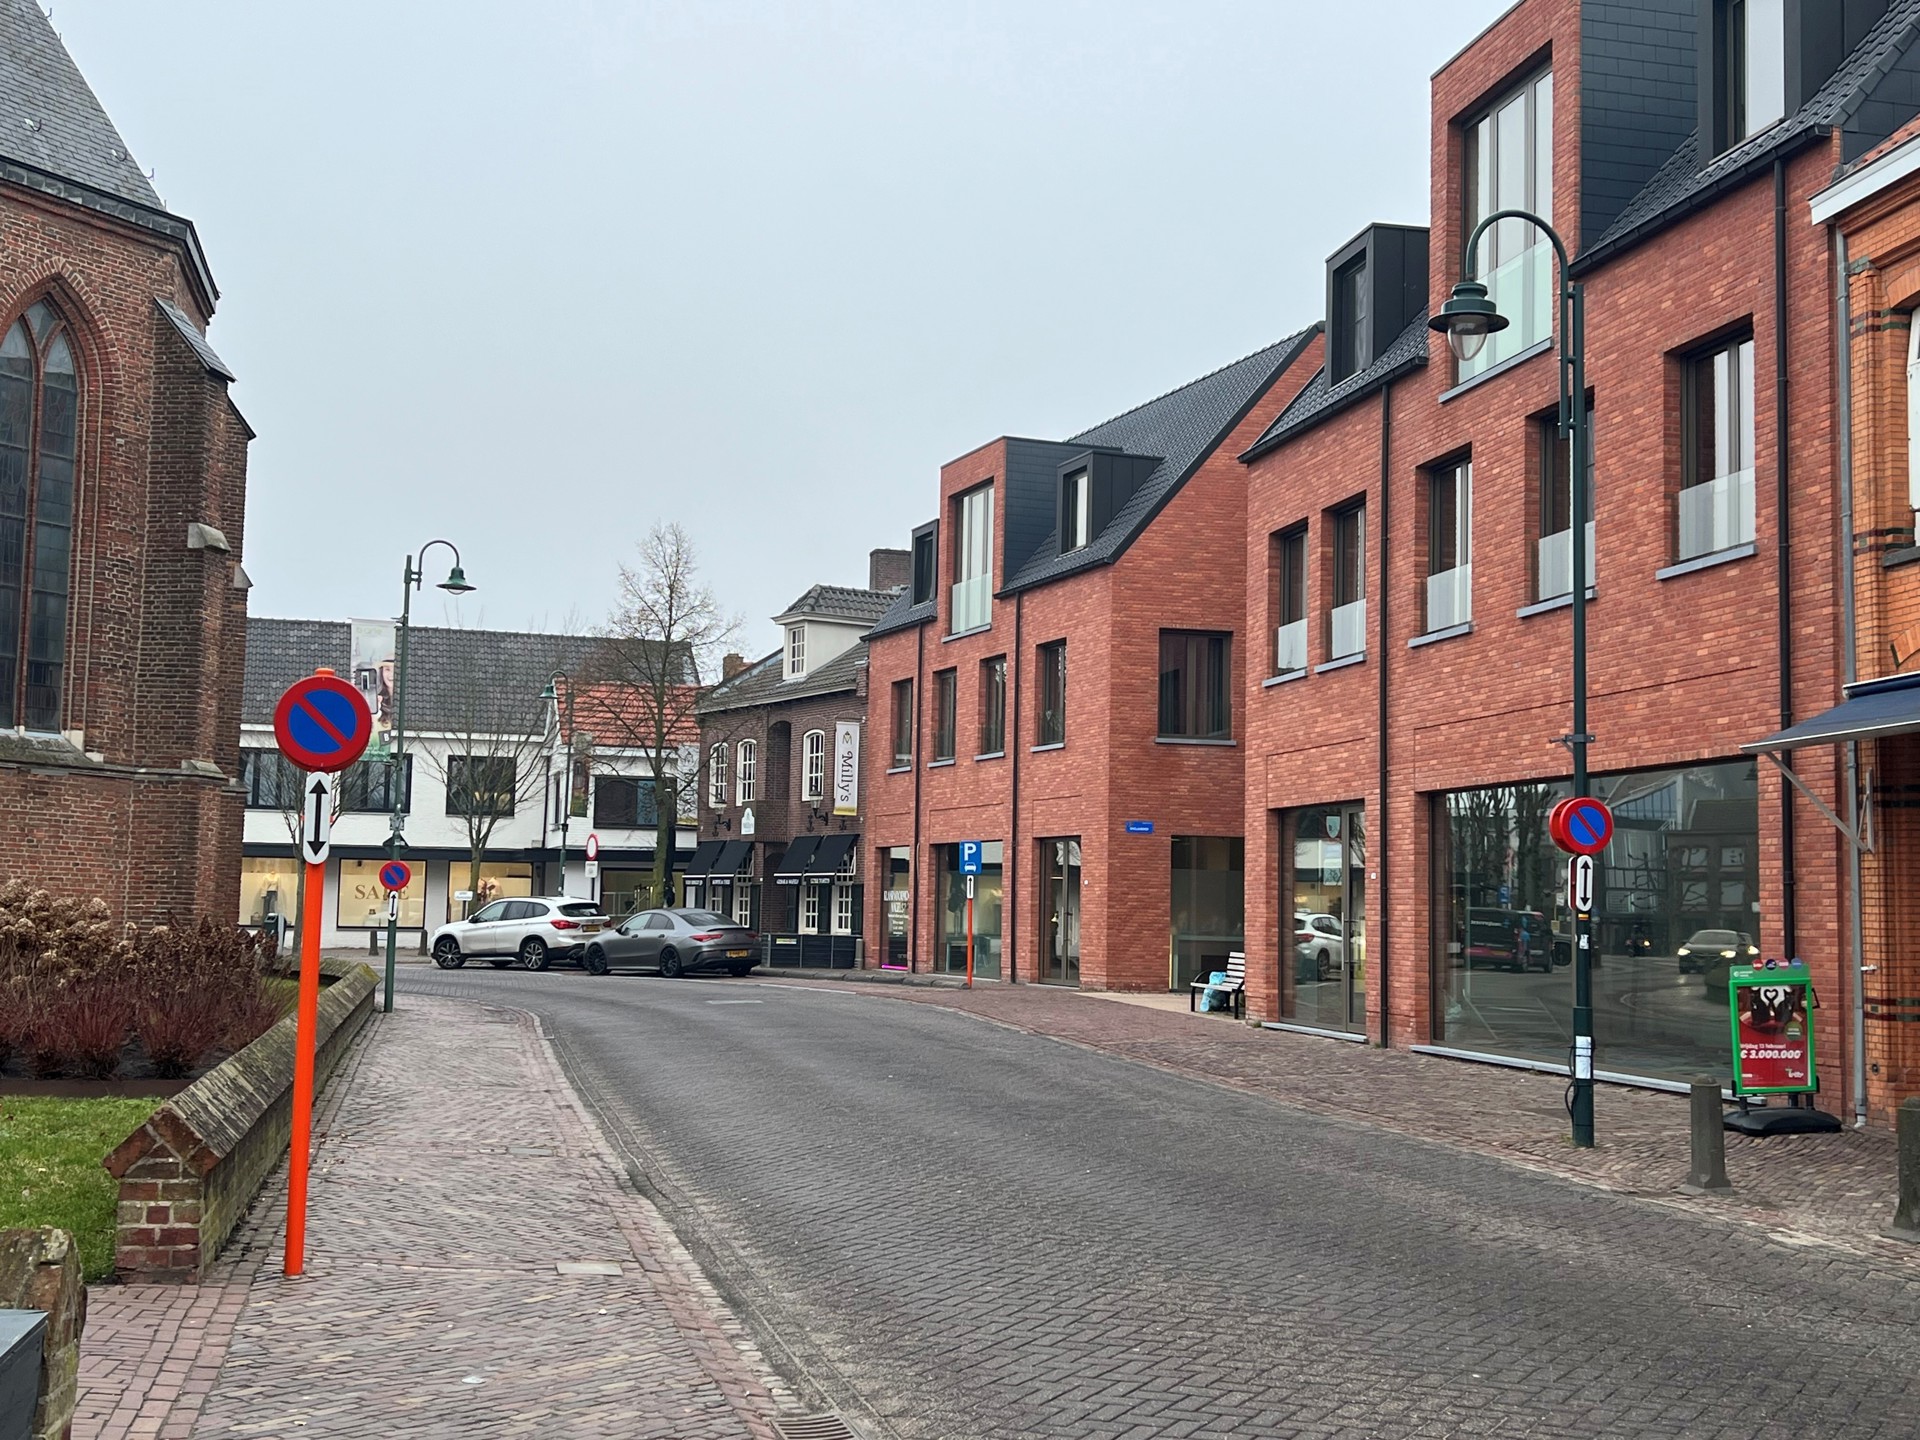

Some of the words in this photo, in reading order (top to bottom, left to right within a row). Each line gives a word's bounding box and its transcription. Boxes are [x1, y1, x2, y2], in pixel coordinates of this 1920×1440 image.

[838, 751, 854, 802] Milly's
[964, 842, 977, 861] P
[354, 884, 410, 901] SAE
[1740, 1050, 1748, 1059] €
